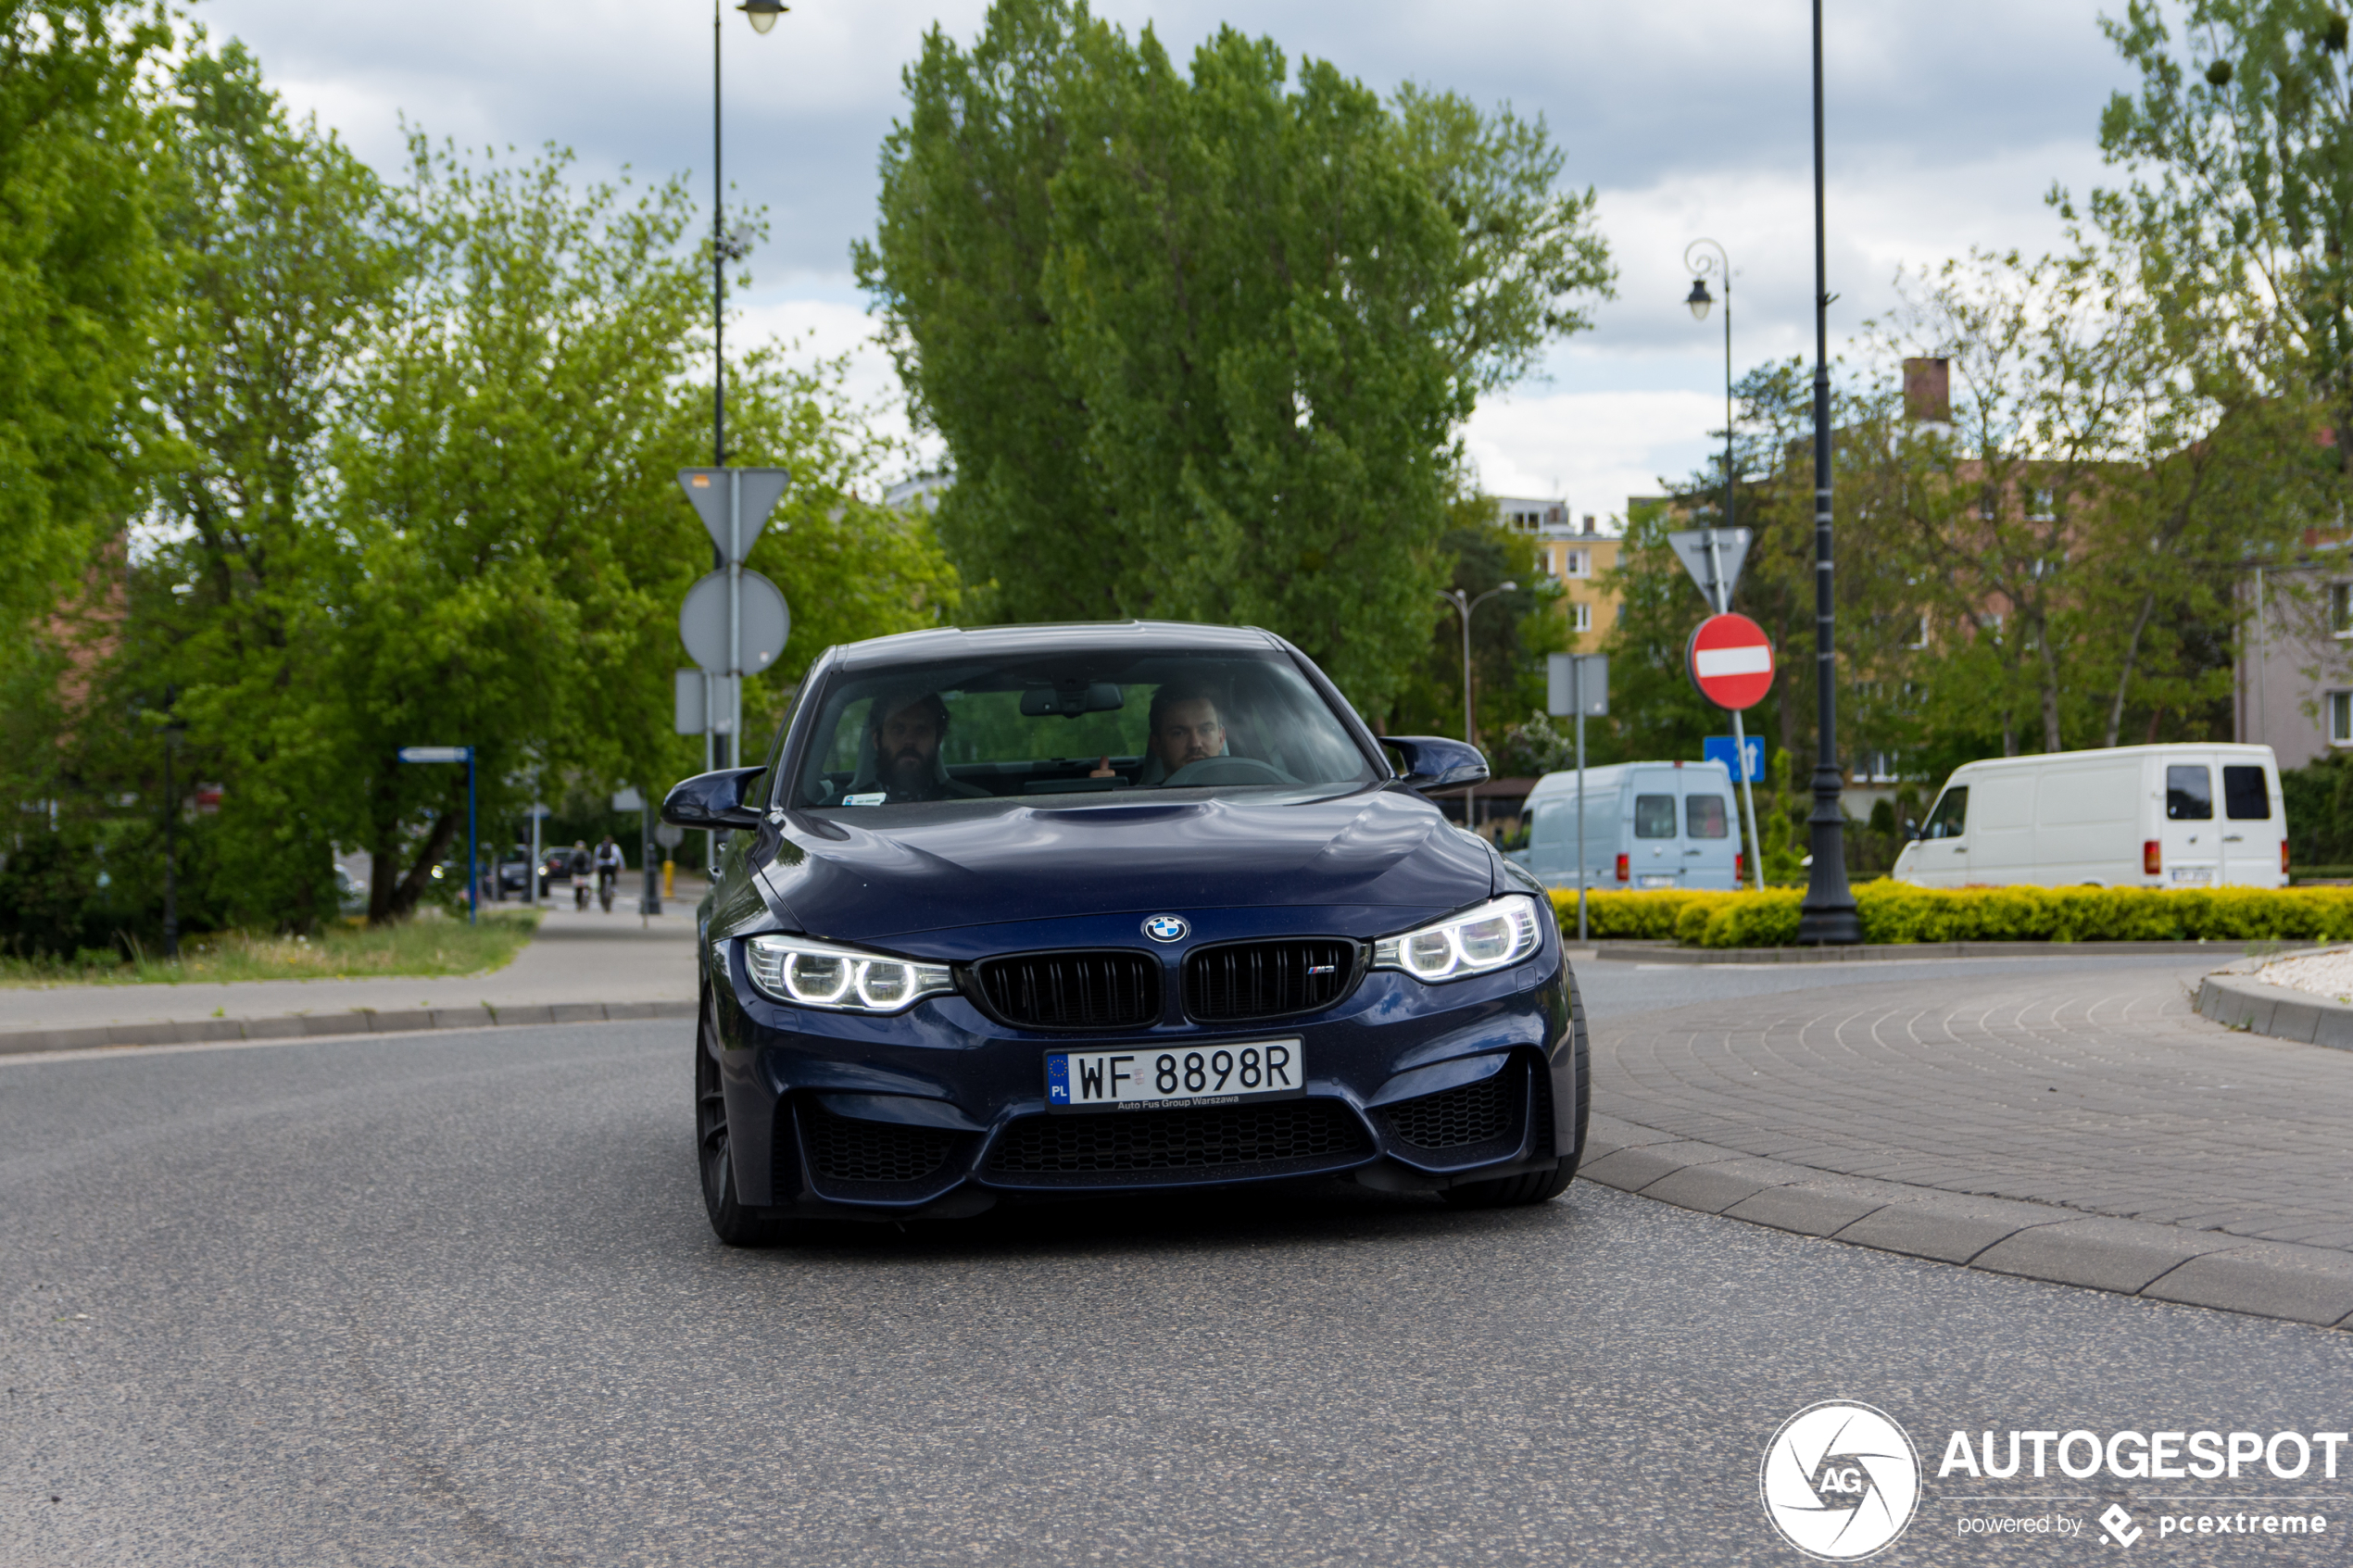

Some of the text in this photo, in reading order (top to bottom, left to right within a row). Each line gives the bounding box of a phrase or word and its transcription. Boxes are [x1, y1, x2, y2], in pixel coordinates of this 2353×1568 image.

[1149, 917, 1183, 926] BMW
[1312, 965, 1335, 973] M3
[1079, 1046, 1290, 1099] WF 8898R
[1051, 1085, 1067, 1097] PL
[1117, 1096, 1239, 1110] Auto Fus Group Warszawa
